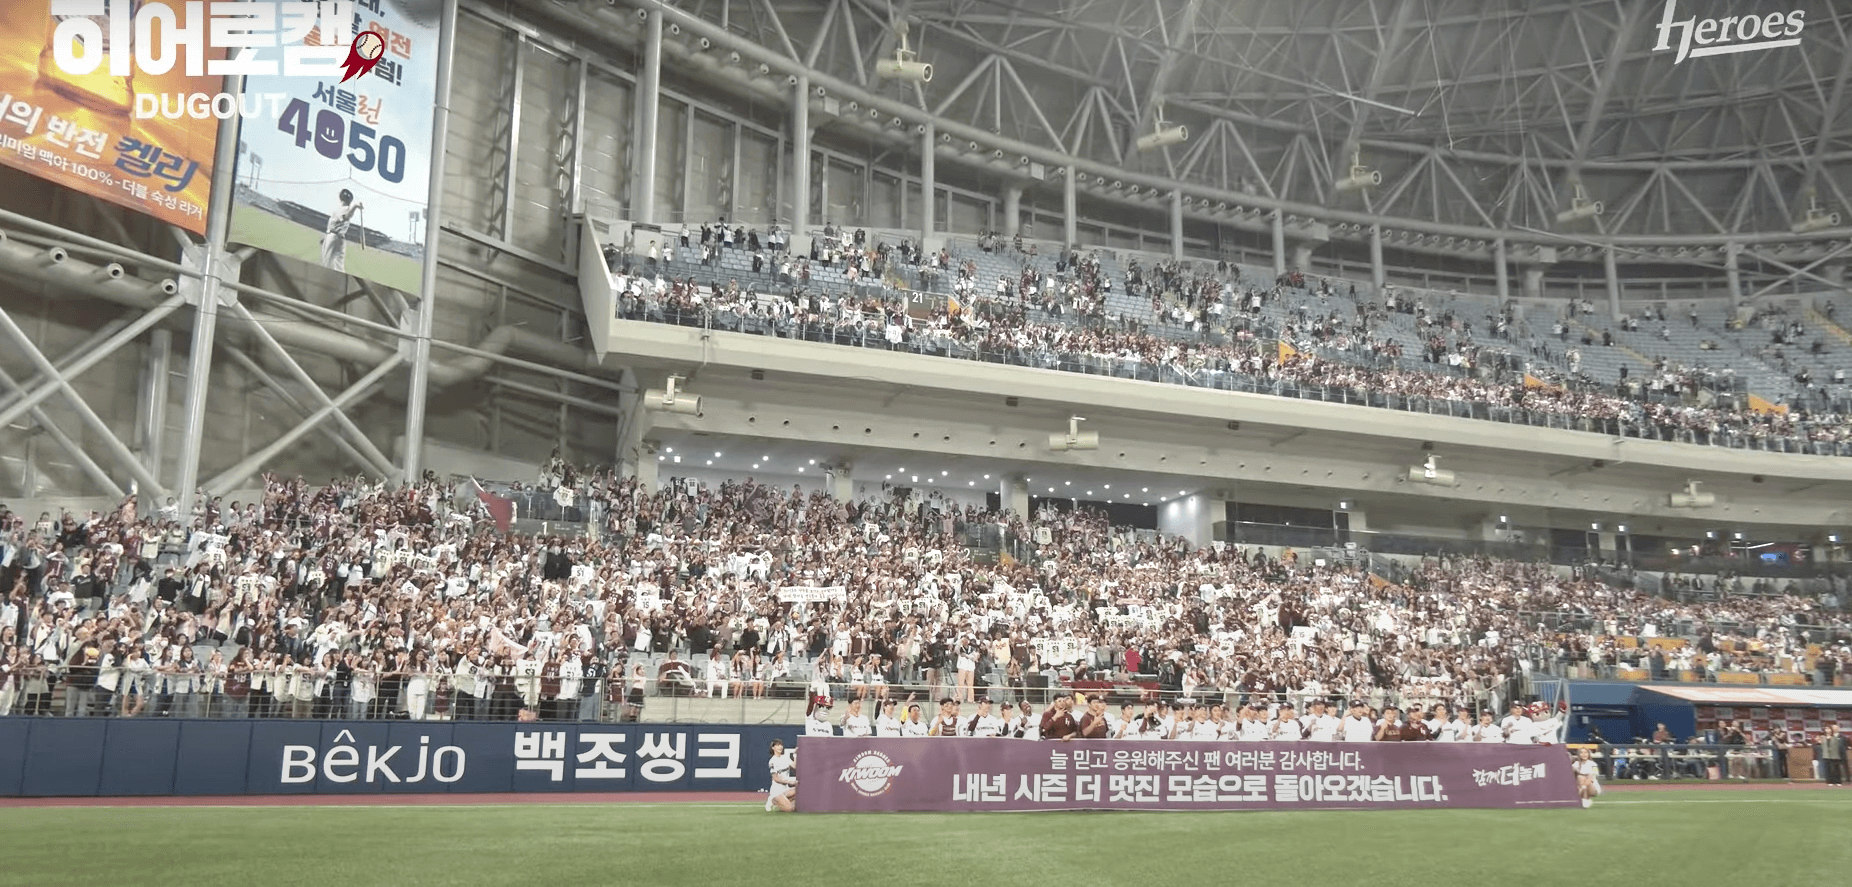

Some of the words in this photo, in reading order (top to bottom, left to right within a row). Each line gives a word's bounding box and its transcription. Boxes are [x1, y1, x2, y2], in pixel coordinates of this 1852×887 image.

[312, 81, 383, 125] 서울런
[45, 115, 109, 160] 반전
[113, 135, 200, 193] 켈리
[278, 97, 406, 184] 4050
[39, 148, 71, 171] 맥아
[71, 162, 114, 186] 100%
[122, 178, 148, 200] 더블
[151, 189, 178, 210] 숙성
[179, 199, 203, 220] 라거
[912, 291, 923, 304] 21
[514, 731, 742, 782] 백조씽크
[839, 765, 904, 783] KIWOOM
[1050, 749, 1069, 770] 늘
[1073, 749, 1109, 770] 믿고
[1112, 749, 1199, 771] 응원해주신
[1203, 750, 1221, 771] 팬
[1225, 750, 1276, 771] 여러분
[1279, 750, 1365, 771] 감사합니다.
[952, 773, 1007, 802] 내년
[1014, 773, 1068, 802] 시즌
[1075, 774, 1102, 802] 더
[1109, 774, 1160, 802] 멋진
[1166, 774, 1268, 802] 모습으로
[1274, 774, 1449, 802] 돌아오겠습니다.
